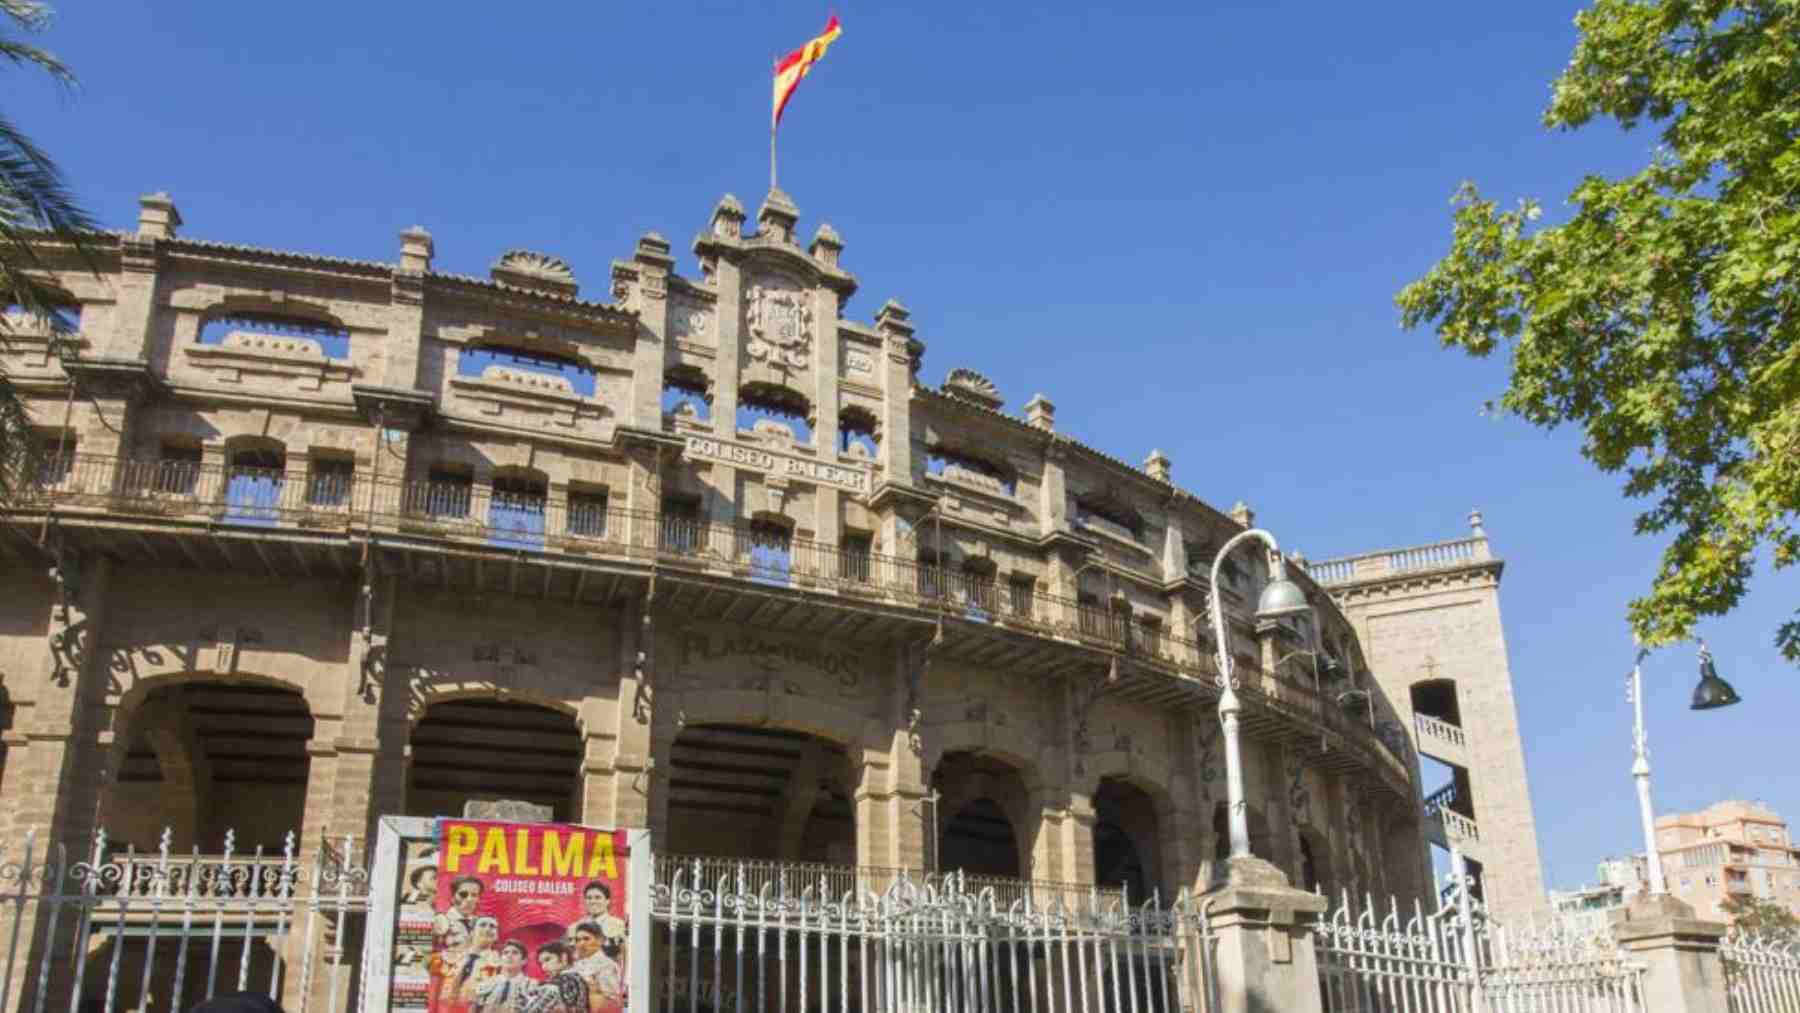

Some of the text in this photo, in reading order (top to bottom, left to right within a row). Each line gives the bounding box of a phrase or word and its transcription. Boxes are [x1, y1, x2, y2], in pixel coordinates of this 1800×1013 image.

[688, 439, 774, 469] COLISEO
[446, 825, 619, 880] PALMA
[495, 879, 574, 895] COLISEO BALEAR
